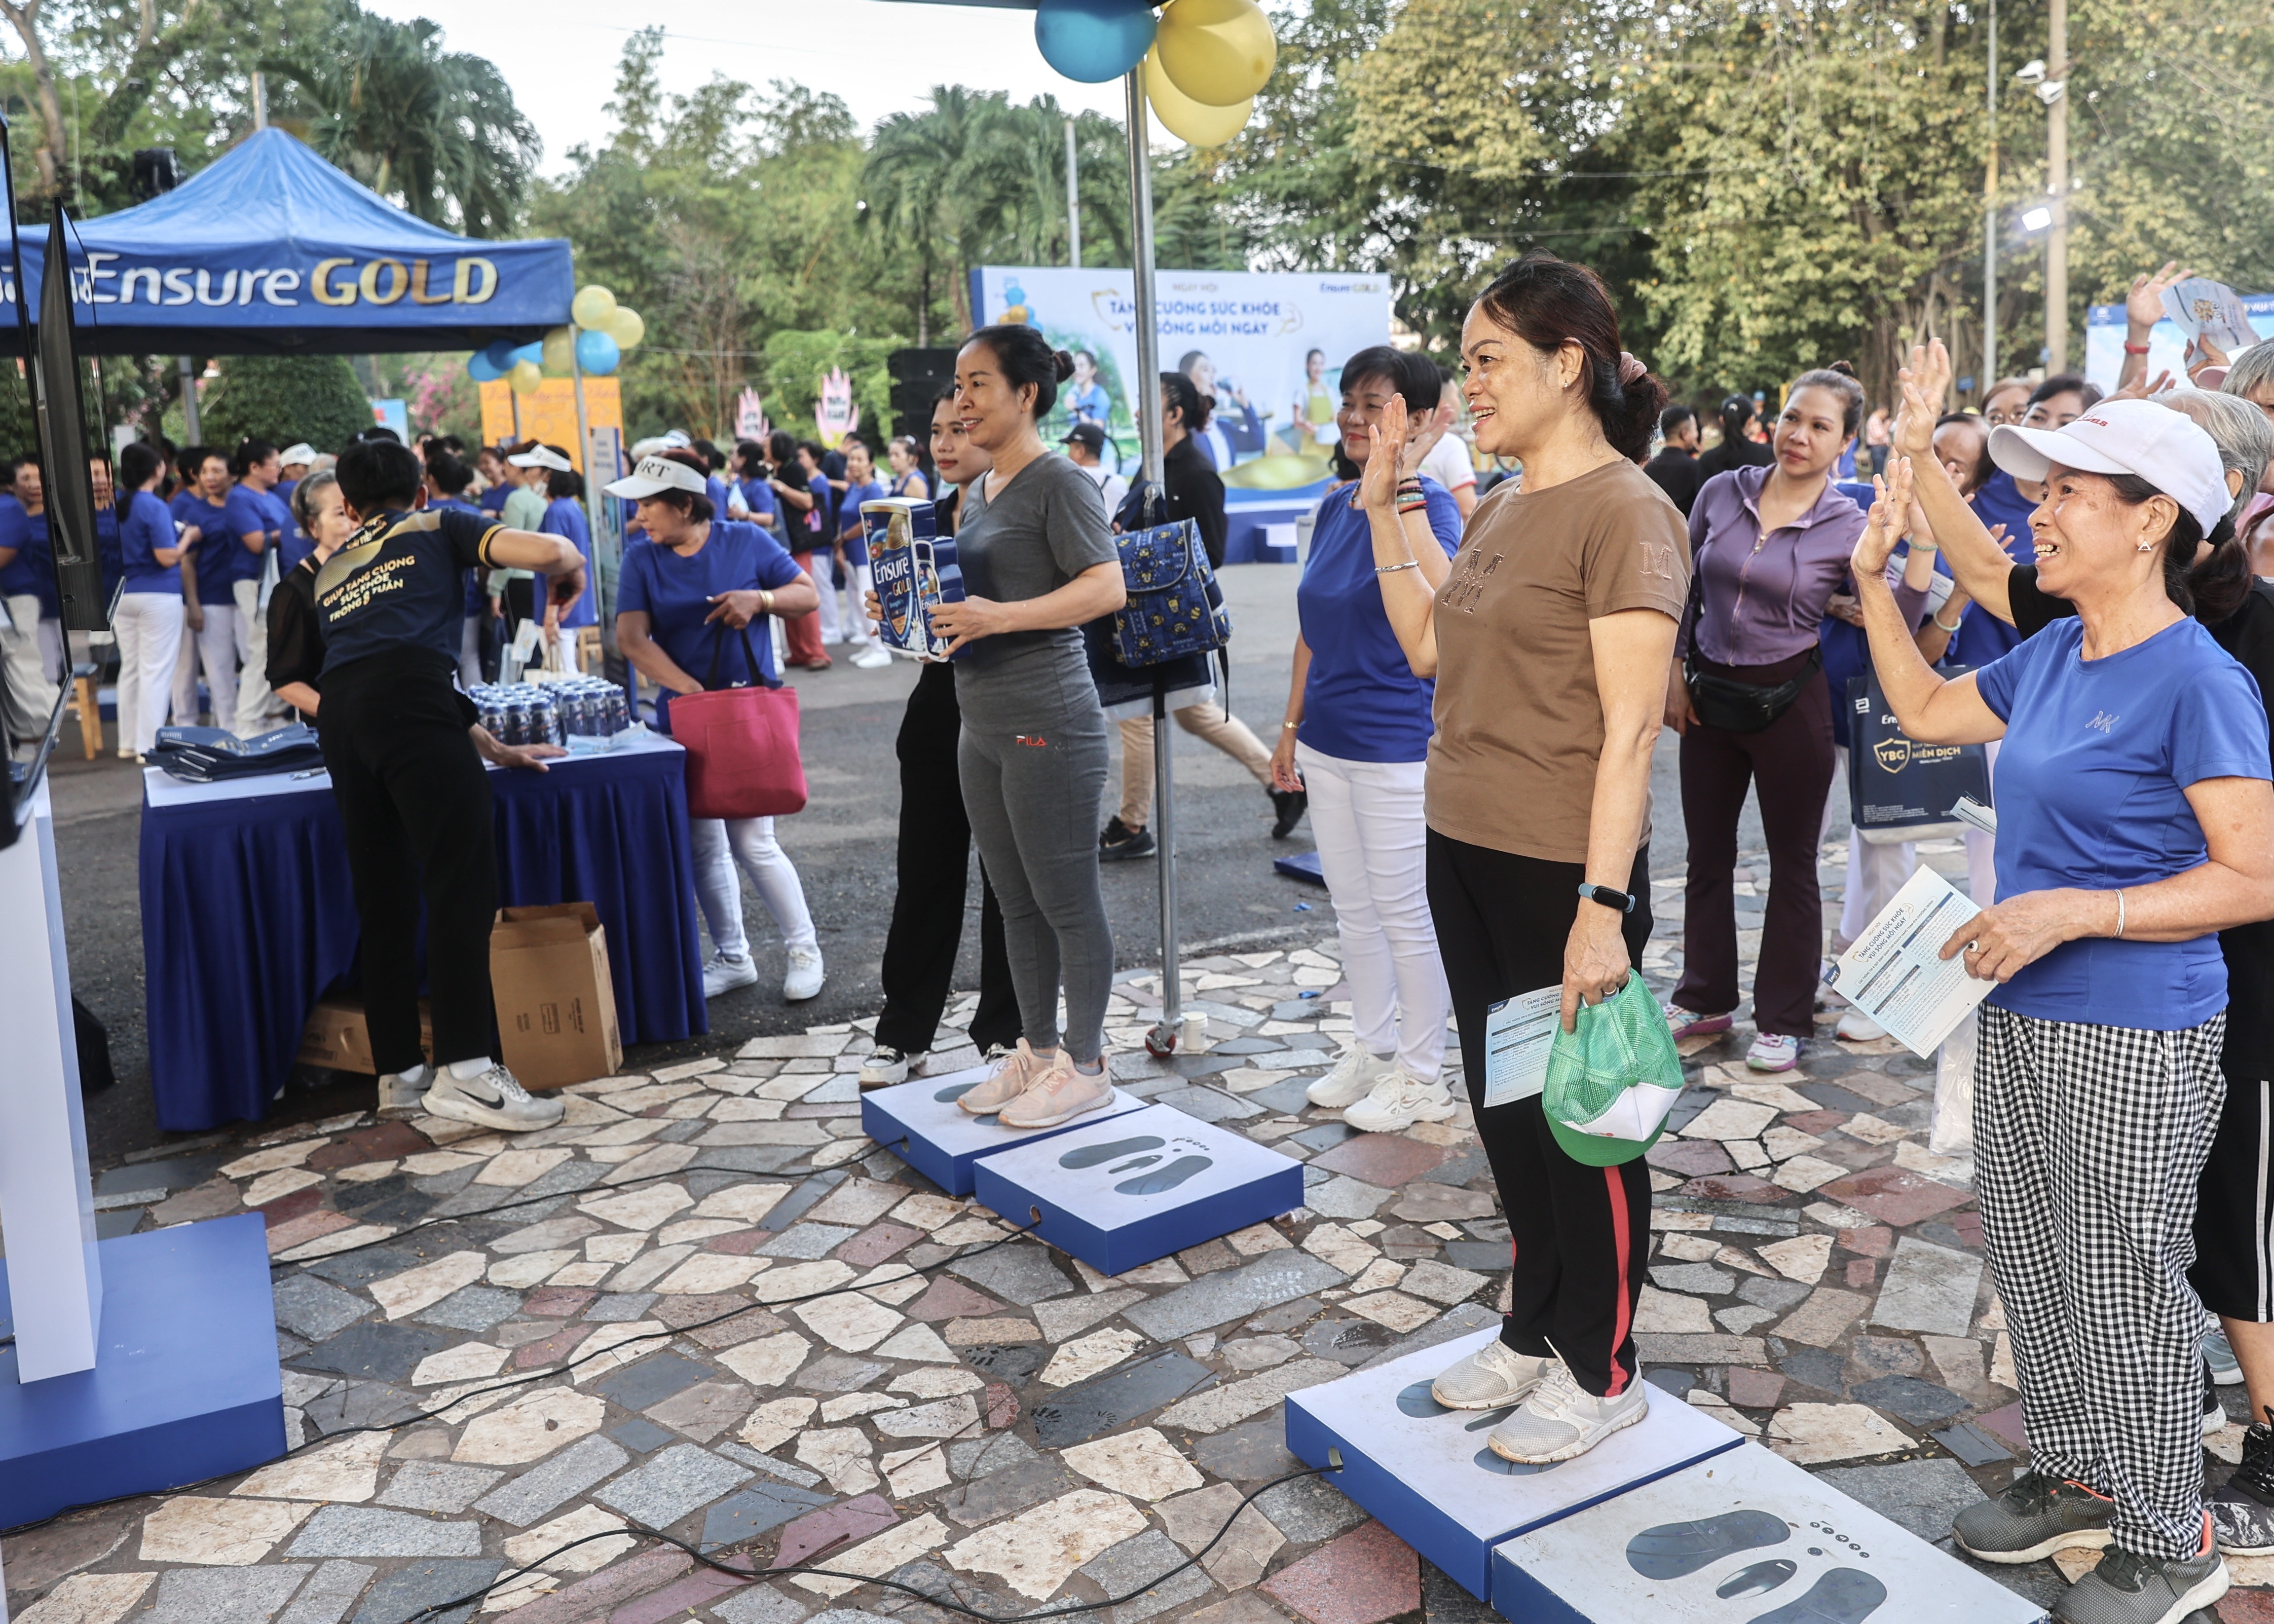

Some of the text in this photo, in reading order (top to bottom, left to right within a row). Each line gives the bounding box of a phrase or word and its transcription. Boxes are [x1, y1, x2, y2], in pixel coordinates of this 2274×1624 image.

[86, 252, 300, 306] Ensure
[310, 257, 500, 306] GOLD
[874, 556, 910, 585] Ensure
[1639, 542, 1672, 580] M
[892, 577, 911, 596] GOLD
[1016, 735, 1046, 746] FILA
[1880, 750, 1906, 762] YBG
[1868, 950, 1877, 960] VUI
